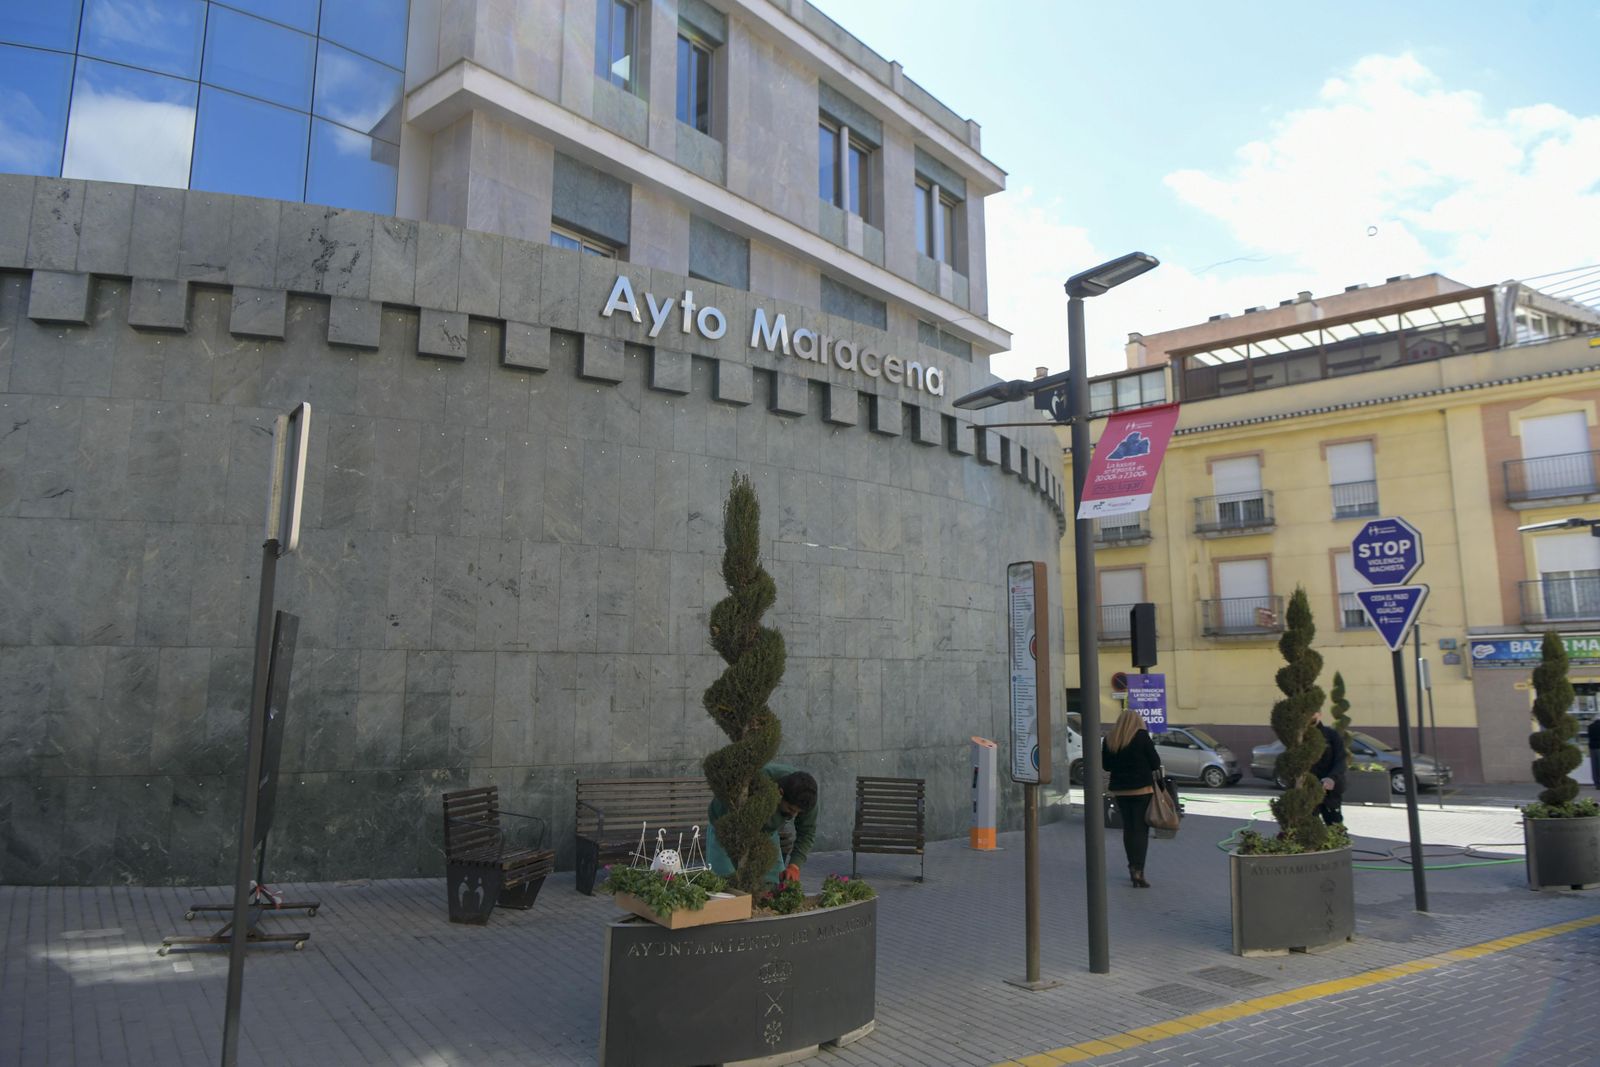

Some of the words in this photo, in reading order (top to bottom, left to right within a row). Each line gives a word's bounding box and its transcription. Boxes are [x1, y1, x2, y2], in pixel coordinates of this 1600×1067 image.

[601, 274, 727, 340] Ayto
[750, 307, 944, 397] Maracena
[1359, 541, 1411, 557] STOP
[1368, 558, 1405, 566] VIOLENCIA
[1151, 708, 1162, 716] ME
[627, 934, 782, 957] AYUNTAMIENTO
